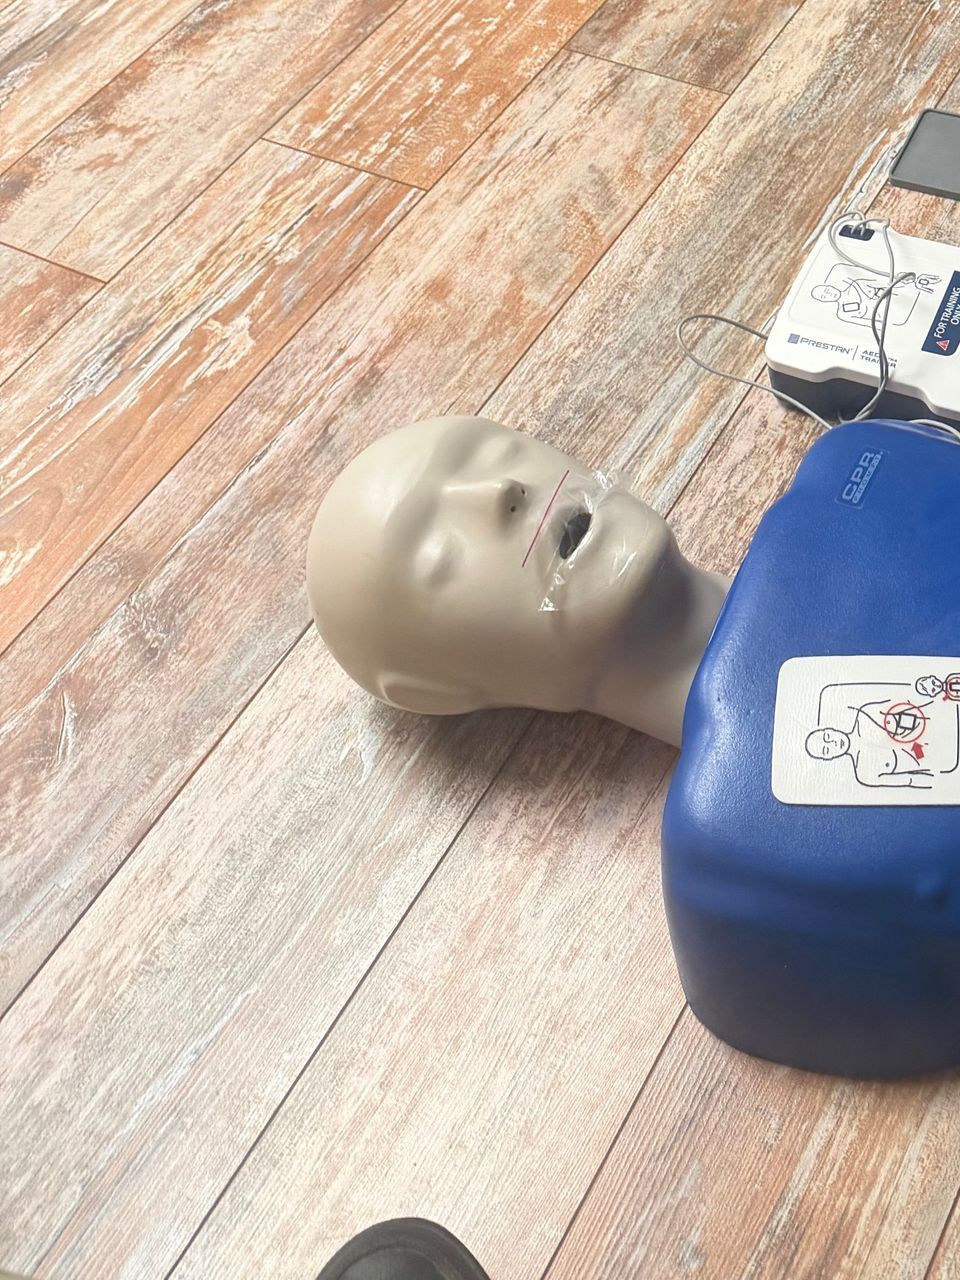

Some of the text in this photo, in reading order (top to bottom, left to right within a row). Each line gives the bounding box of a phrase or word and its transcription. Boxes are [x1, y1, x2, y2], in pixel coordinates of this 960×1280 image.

[934, 321, 948, 339] FOR
[800, 337, 850, 354] PRESTAN
[842, 452, 875, 500] CPR
